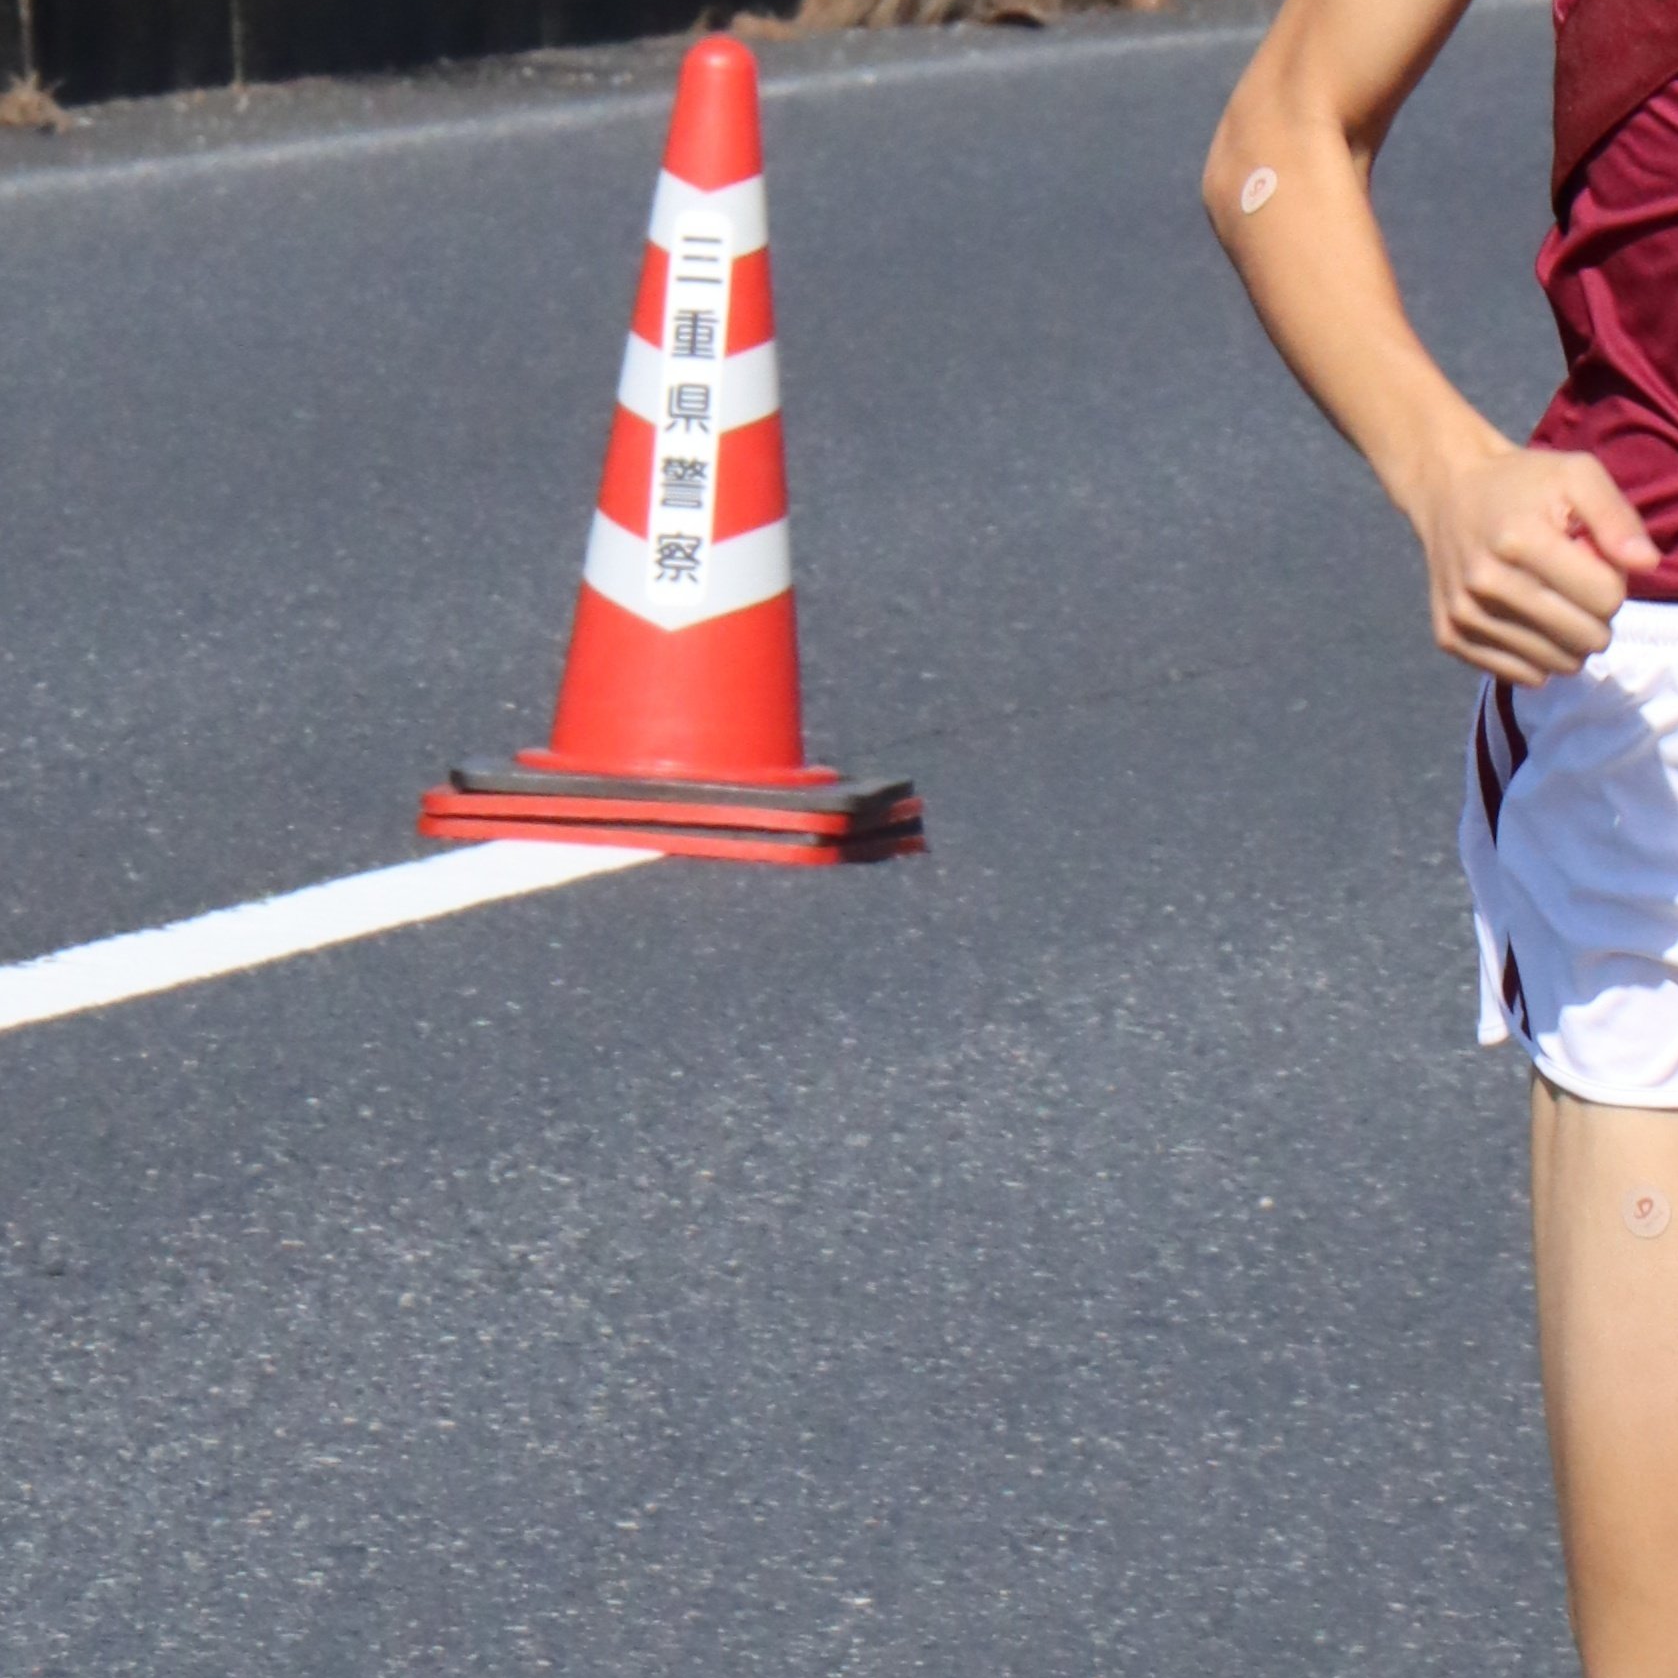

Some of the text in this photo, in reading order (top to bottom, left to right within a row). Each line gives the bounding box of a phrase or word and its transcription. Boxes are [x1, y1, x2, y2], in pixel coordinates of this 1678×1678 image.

[654, 234, 724, 585] 三重県警察
